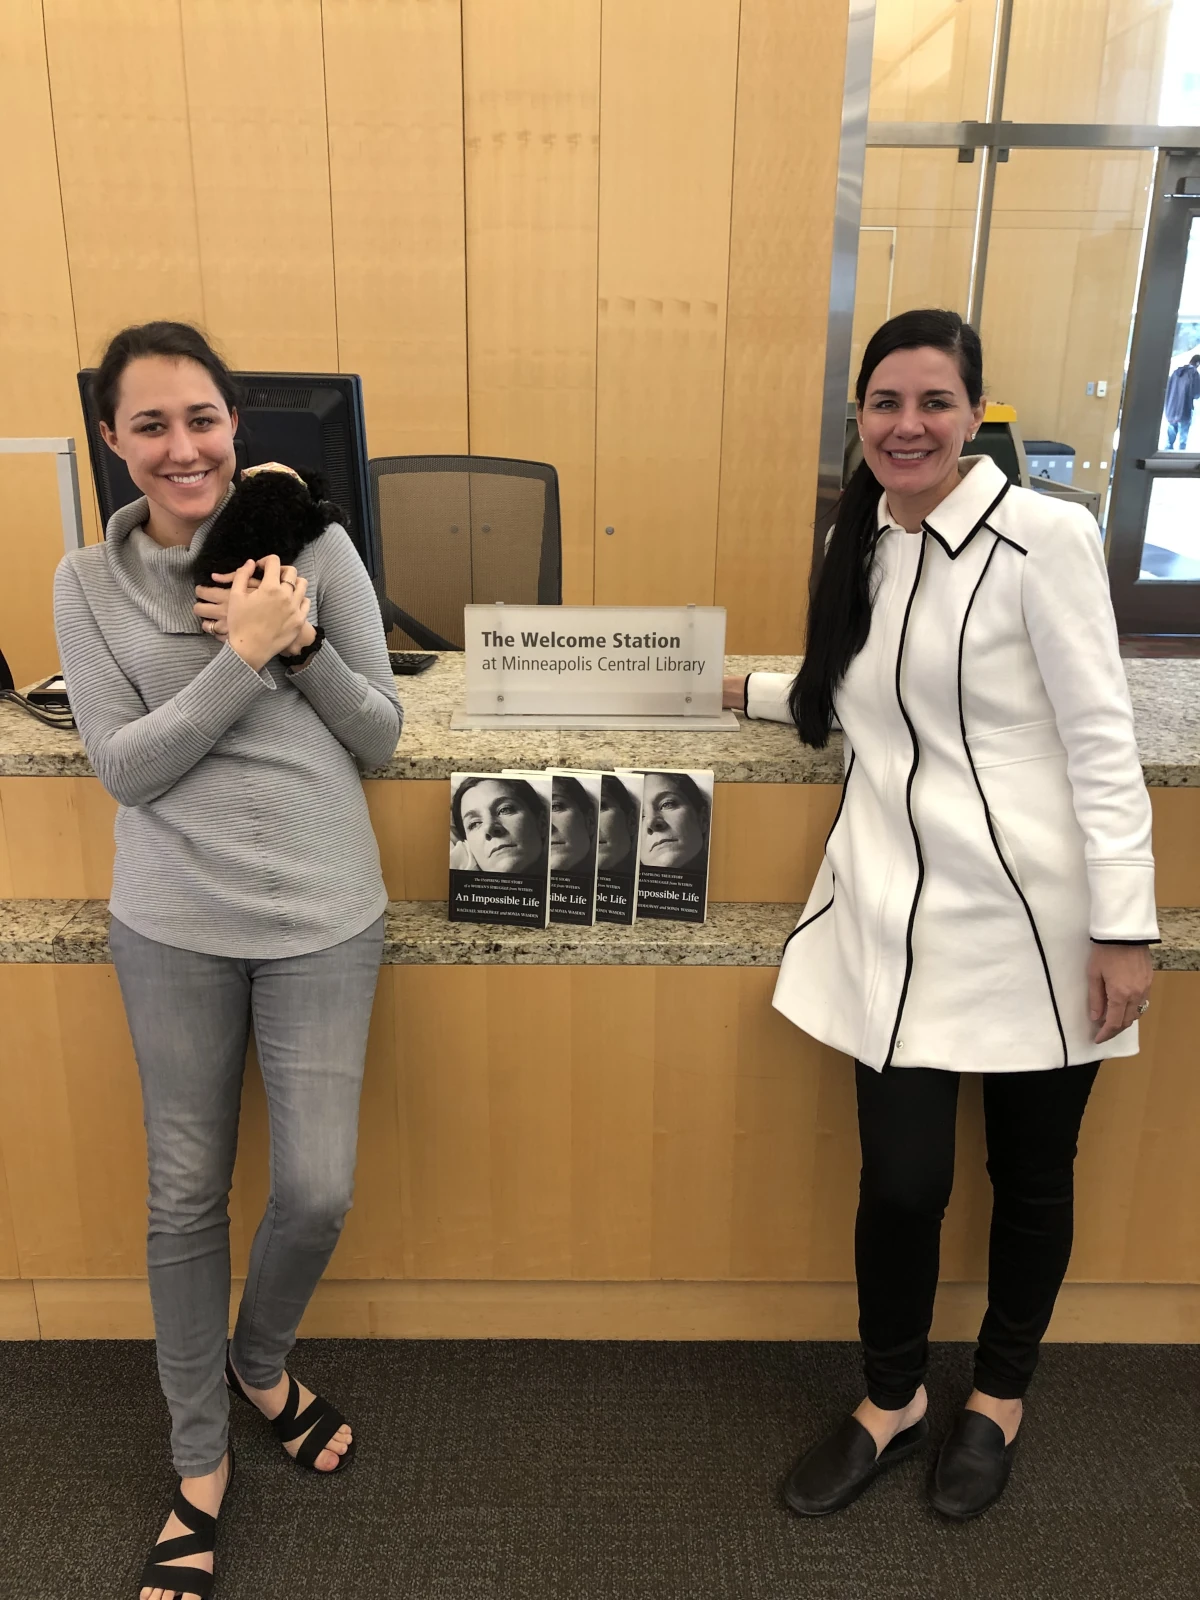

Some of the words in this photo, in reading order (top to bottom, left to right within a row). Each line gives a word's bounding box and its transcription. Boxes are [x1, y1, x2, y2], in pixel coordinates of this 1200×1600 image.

[481, 631, 515, 647] The
[521, 632, 606, 648] Welcome
[613, 632, 680, 648] Station
[482, 658, 497, 670] at
[502, 656, 592, 674] Minneapolis
[598, 656, 650, 671] Central
[656, 656, 705, 675] Library
[456, 893, 468, 901] An
[472, 894, 520, 905] Impossible
[522, 898, 540, 907] Life
[570, 895, 587, 904] Life
[610, 894, 626, 904] Life
[638, 890, 679, 899] mpossible
[682, 892, 699, 902] Life
